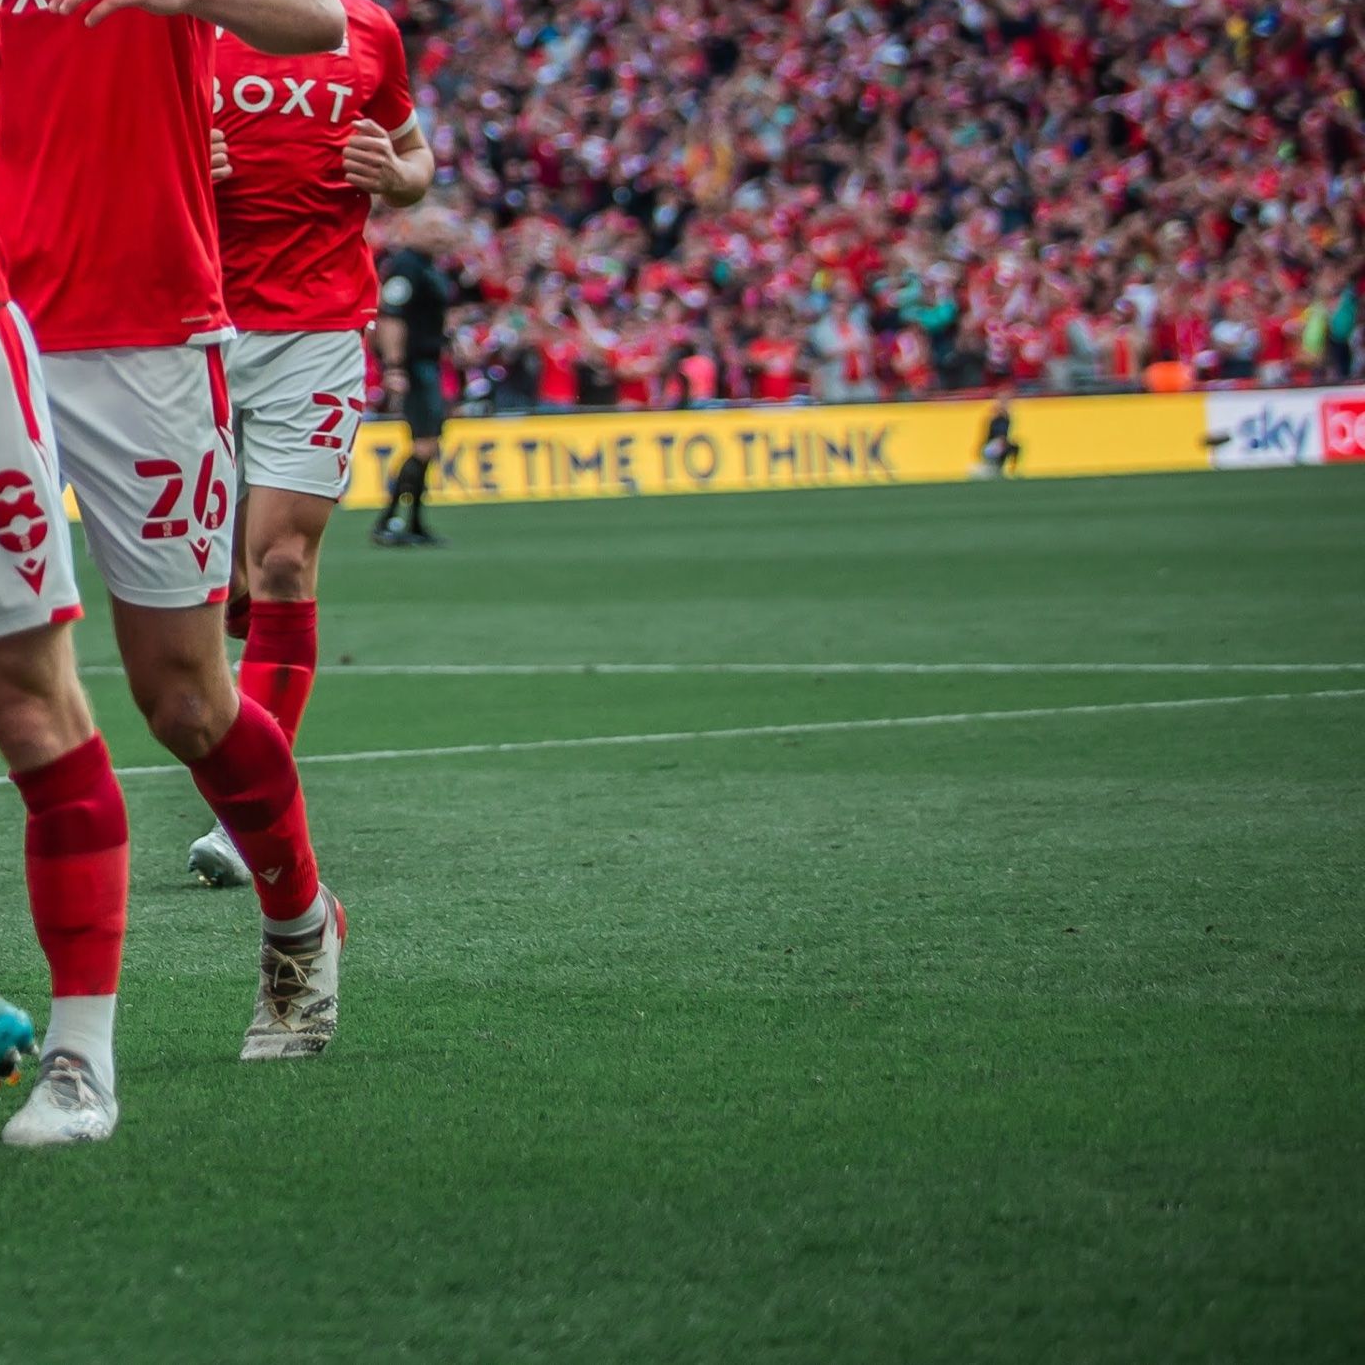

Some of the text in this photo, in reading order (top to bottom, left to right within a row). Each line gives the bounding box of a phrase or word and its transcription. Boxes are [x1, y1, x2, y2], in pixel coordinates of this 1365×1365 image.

[517, 435, 633, 490] TIME
[657, 432, 717, 483] TO
[739, 425, 896, 485] THINK
[1241, 405, 1311, 466] sky
[134, 449, 227, 539] 26
